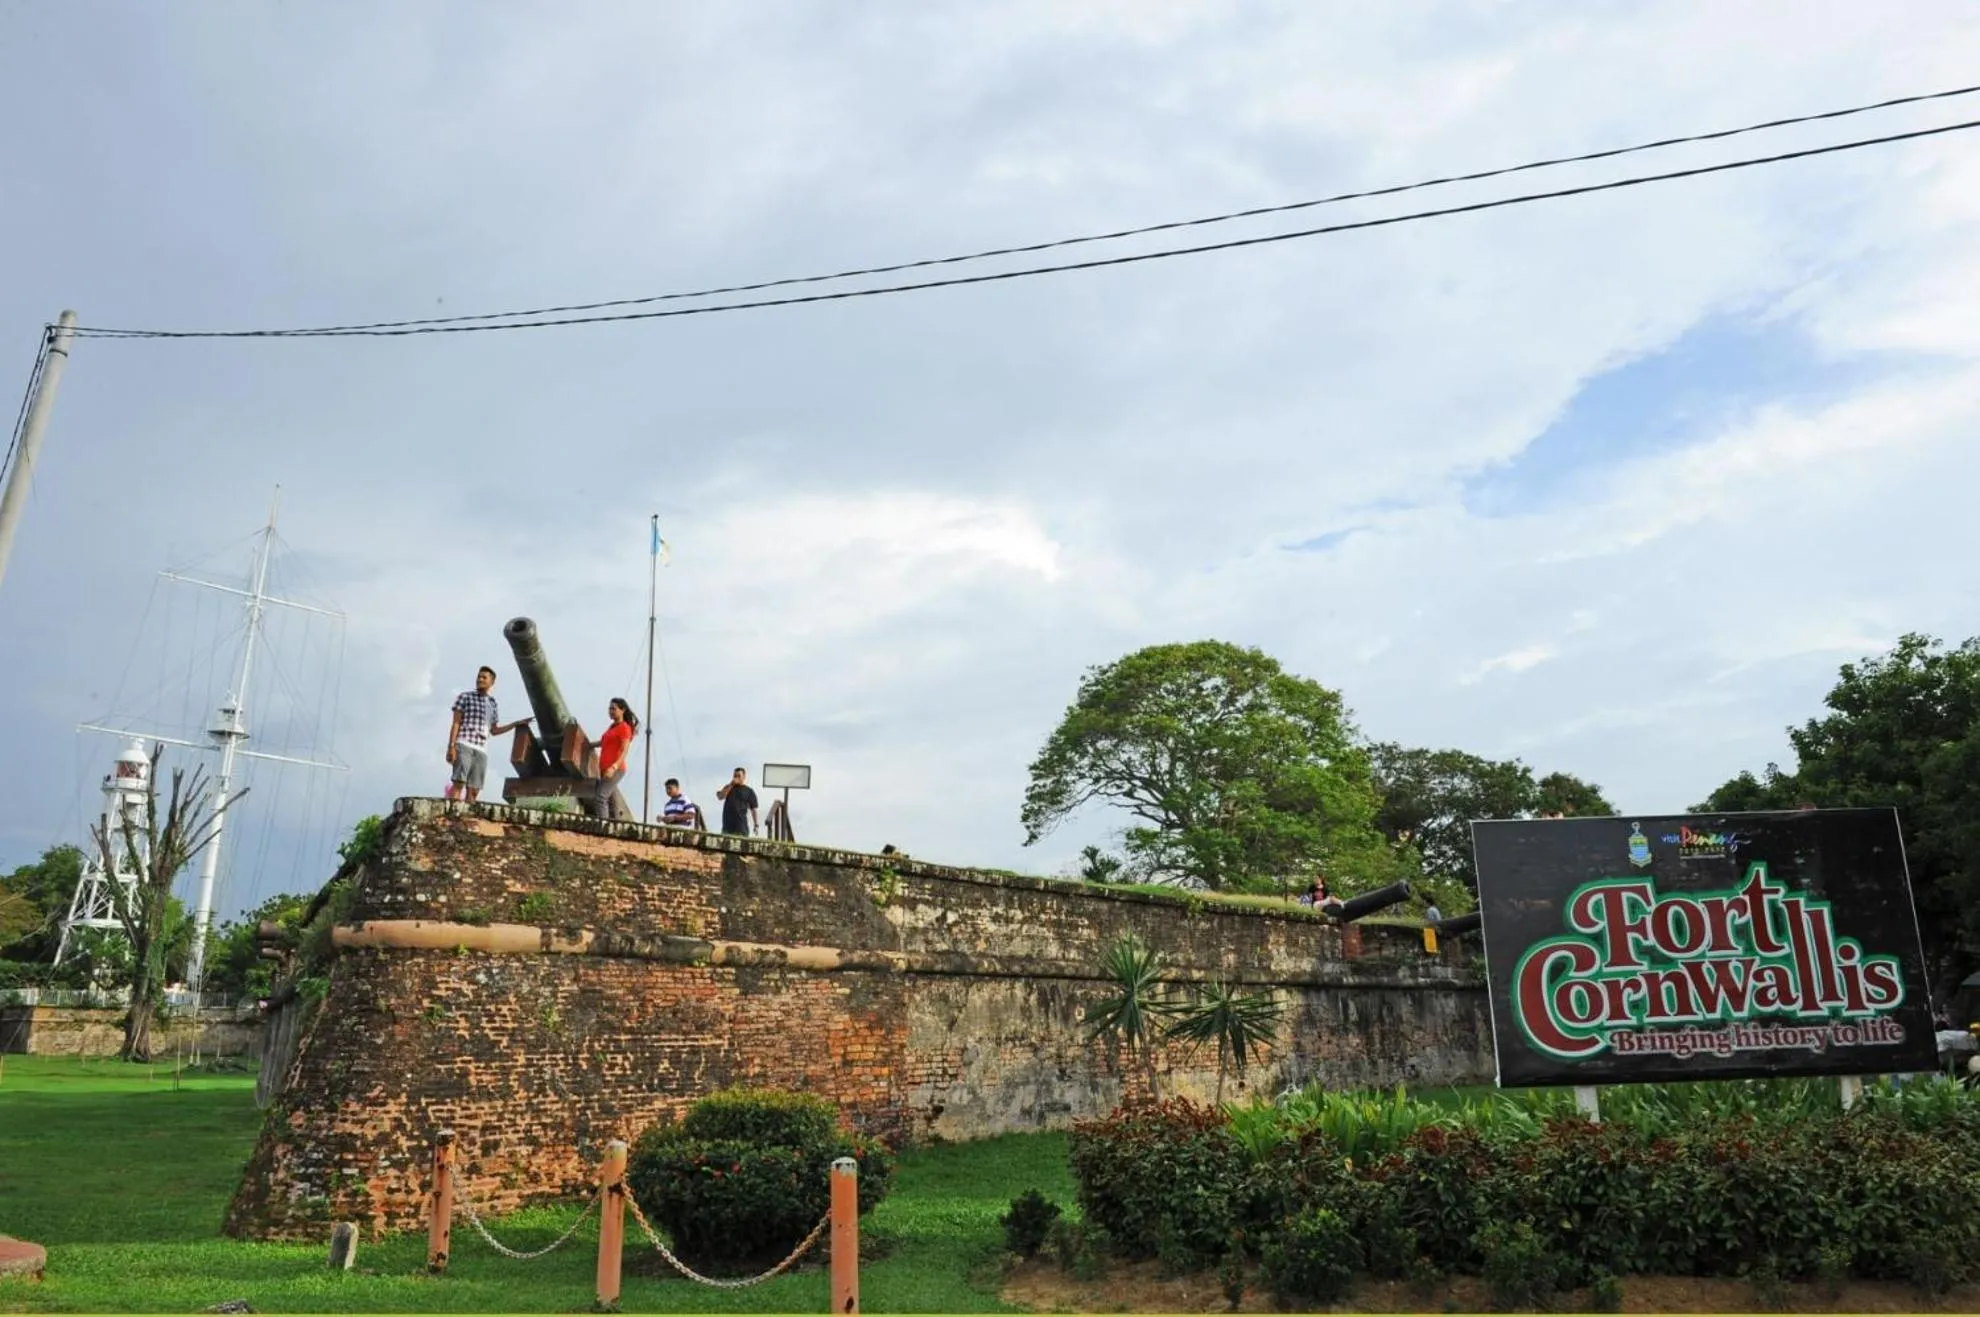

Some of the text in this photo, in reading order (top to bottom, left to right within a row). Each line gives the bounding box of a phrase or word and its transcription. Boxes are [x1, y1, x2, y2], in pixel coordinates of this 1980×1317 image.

[1680, 824, 1750, 852] Penang
[1571, 867, 1789, 970] Fort
[1517, 897, 1903, 1056] Cornwallis
[1612, 1018, 1903, 1056] Bringing history to life
